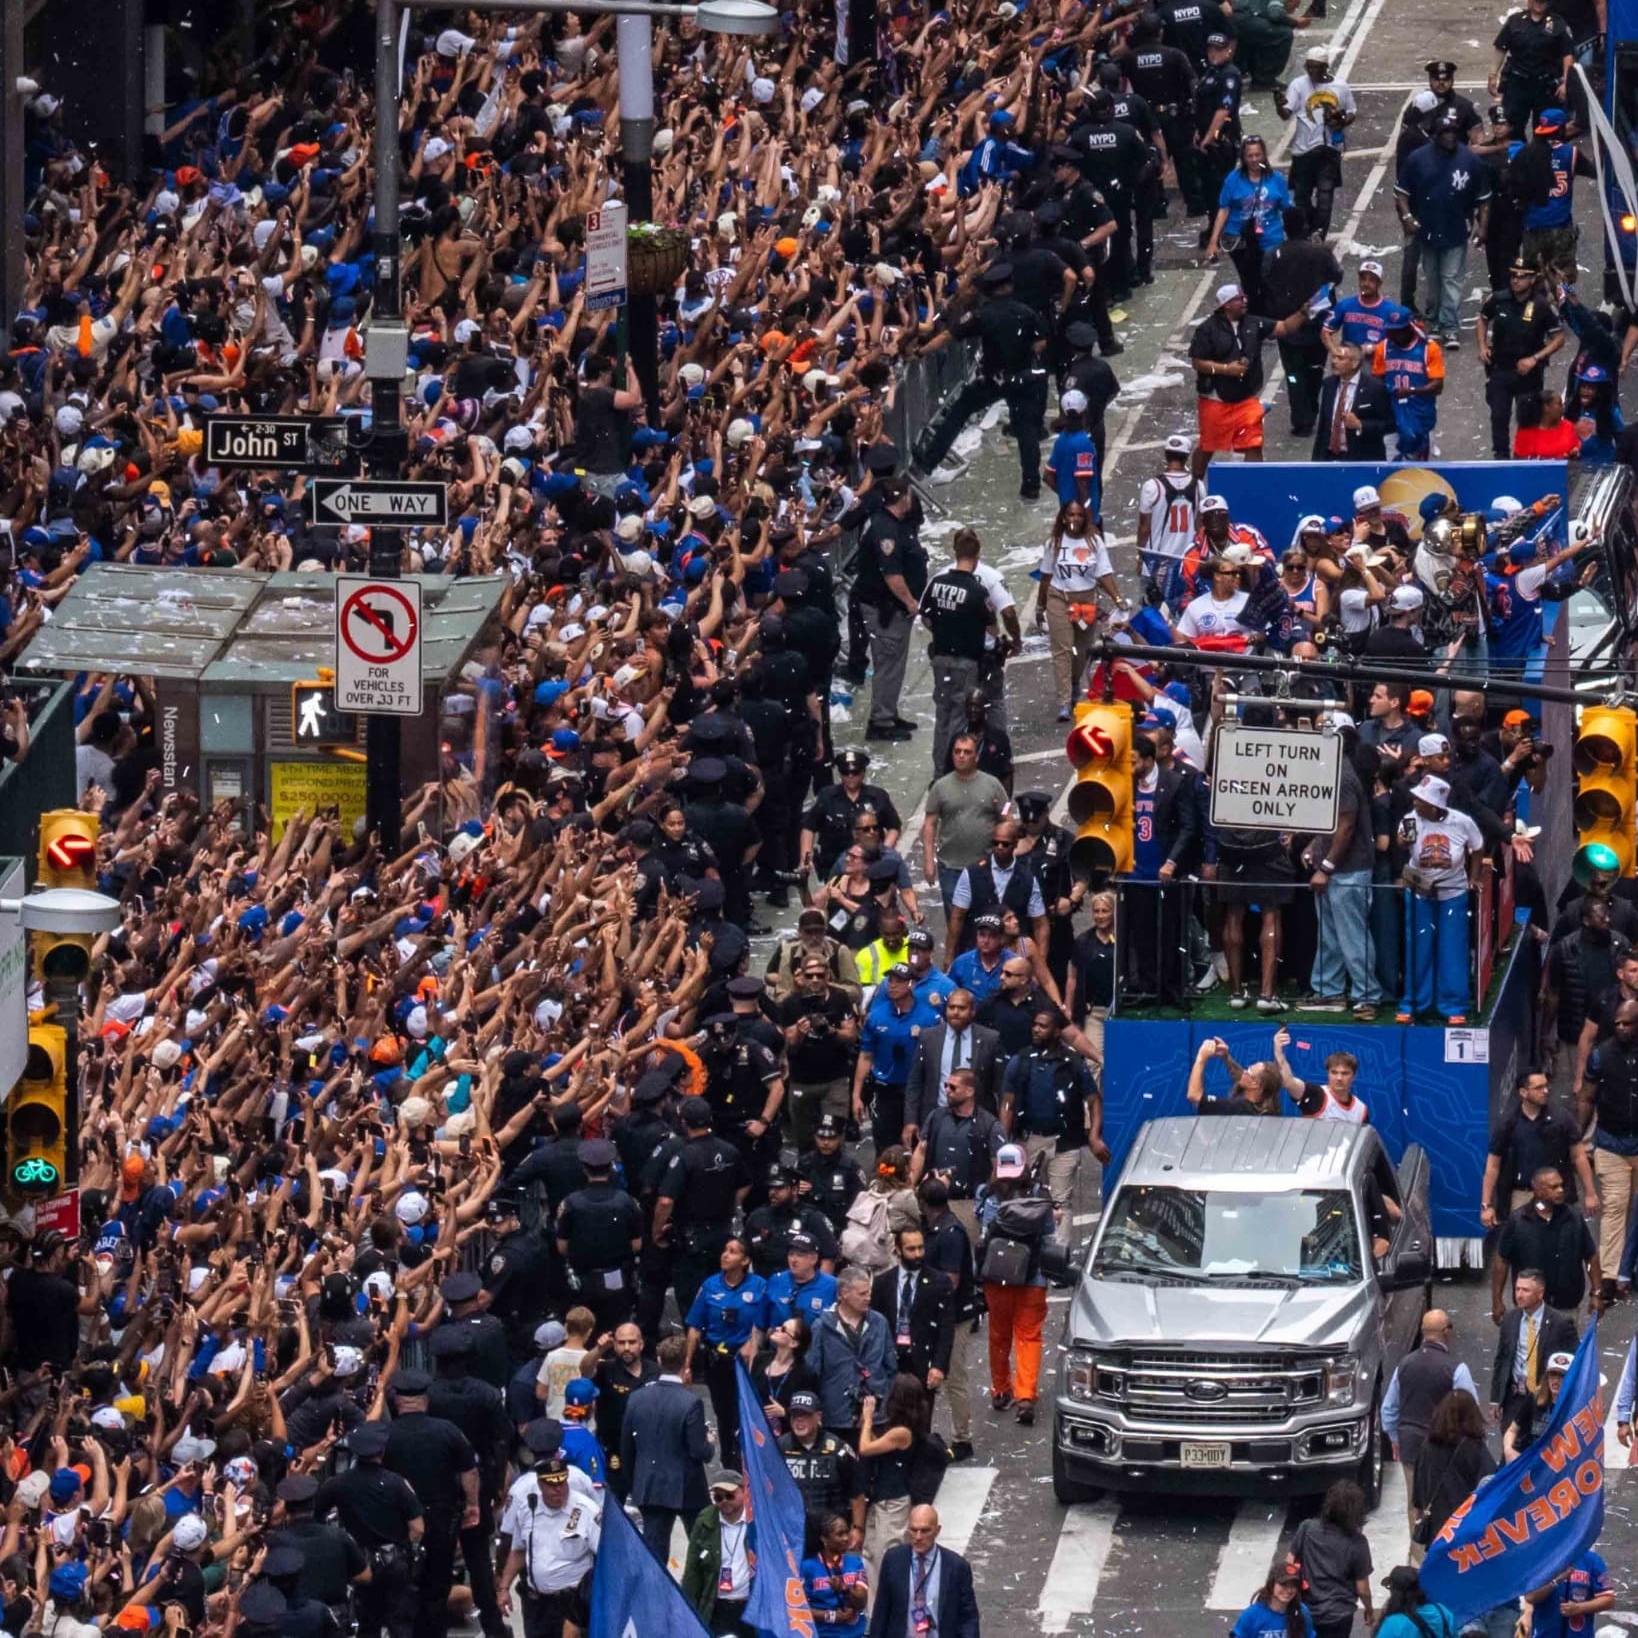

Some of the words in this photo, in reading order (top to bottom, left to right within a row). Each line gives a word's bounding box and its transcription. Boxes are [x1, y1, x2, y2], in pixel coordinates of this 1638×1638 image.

[1174, 6, 1200, 19] NYPD
[1137, 53, 1163, 65] NYPD
[1089, 133, 1116, 147] NYPD
[590, 213, 598, 230] 3
[255, 424, 276, 435] 2-30
[217, 431, 278, 457] John
[283, 432, 298, 446] ST
[334, 494, 372, 512] ONE
[389, 495, 428, 513] WAY
[1169, 504, 1188, 533] 11
[1059, 546, 1067, 562] I
[1058, 563, 1090, 580] NY
[930, 582, 969, 603] NYPD
[368, 667, 389, 679] FOR
[353, 679, 405, 693] VEHICLES
[345, 692, 374, 705] OVER
[397, 695, 411, 707] FT
[1235, 741, 1273, 758] LEFT
[1278, 744, 1320, 761] TURN
[1265, 763, 1288, 778] ON
[1218, 779, 1270, 796] GREEN
[1276, 783, 1333, 800] ARROW
[1252, 800, 1297, 817] ONLY
[1137, 816, 1153, 842] 3
[1455, 1042, 1465, 1059] 1
